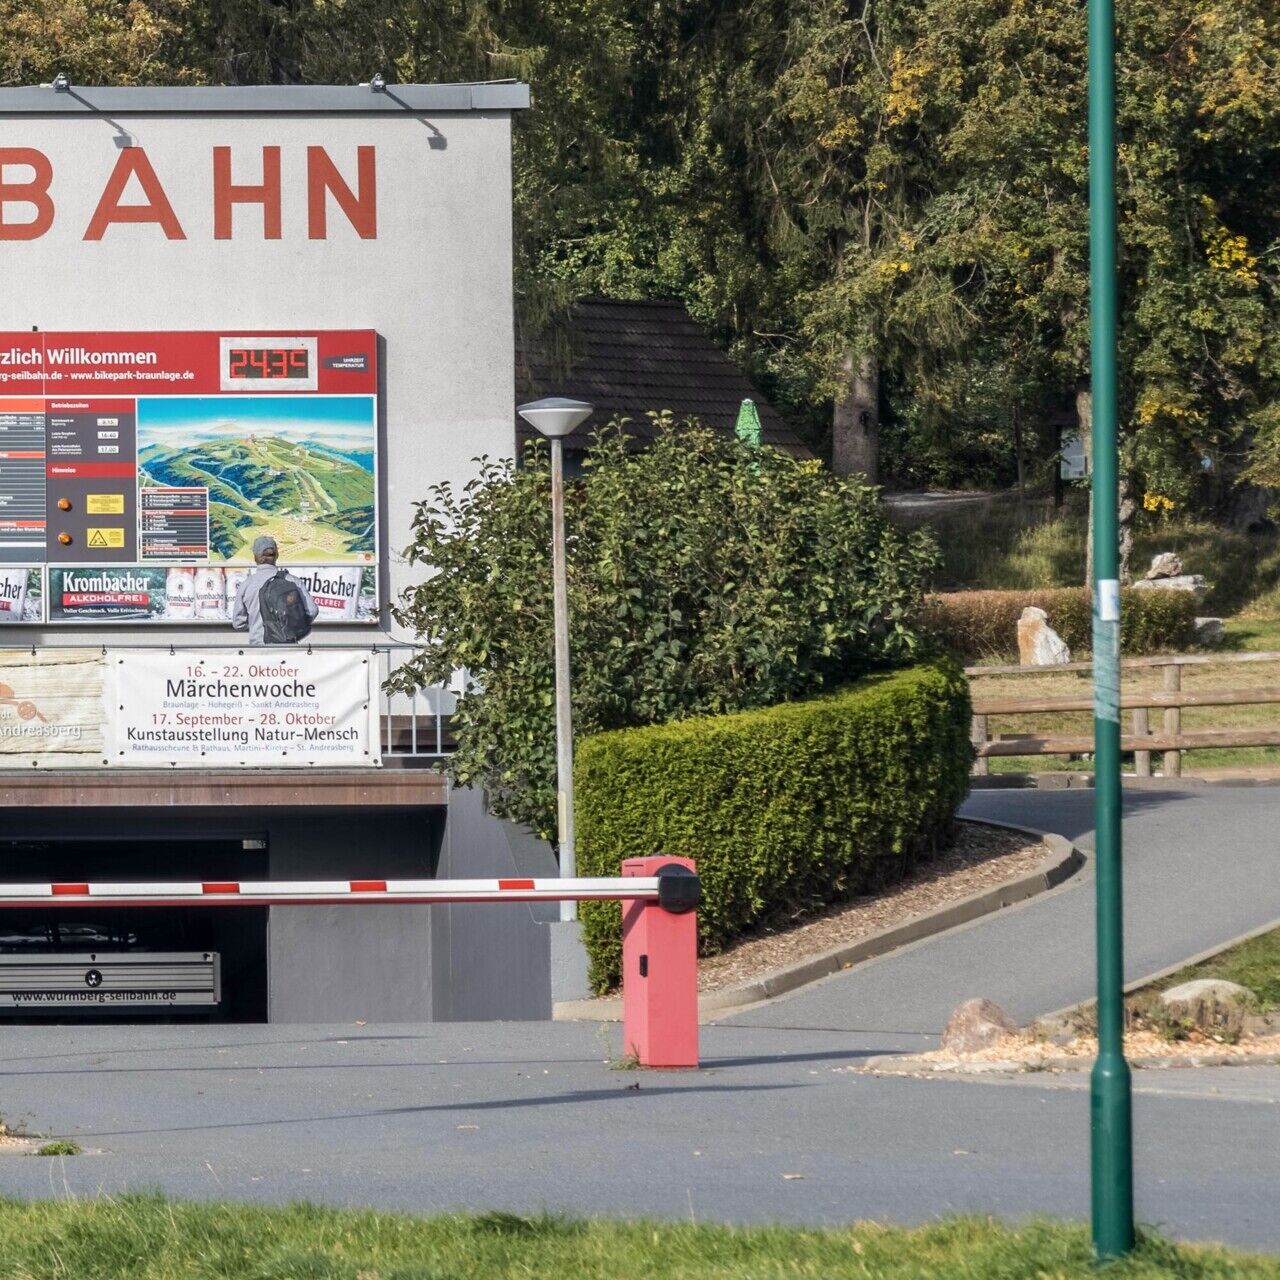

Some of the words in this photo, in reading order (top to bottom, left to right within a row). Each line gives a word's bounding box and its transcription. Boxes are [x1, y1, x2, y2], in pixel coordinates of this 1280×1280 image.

[47, 348, 157, 365] Willkommen
[70, 370, 194, 382] www.bikepark-braunlage.de
[63, 571, 150, 592] Krombacher
[300, 572, 356, 598] mbacher
[69, 594, 143, 602] ALKOHOLFREI
[186, 665, 206, 677] 16.
[223, 665, 244, 677] 22.
[248, 664, 299, 677] Oktober
[166, 679, 316, 698] Märchenwoche
[163, 700, 199, 710] Braunlage
[252, 700, 272, 709] Sankt
[275, 700, 320, 710] Andreasberg
[152, 713, 171, 725] 17.
[176, 713, 244, 727] September
[260, 713, 281, 725] 28.
[285, 713, 336, 725] Oktober
[127, 727, 249, 743] Kunstausstellung
[255, 727, 359, 741] Natur-Mensch
[132, 743, 190, 752] Rathausscheune
[234, 743, 288, 752] Martini-Kirche
[297, 743, 309, 751] St.
[311, 743, 354, 753] Andreasberg
[12, 990, 177, 1003] www.wurmberg-seilbahn.de
